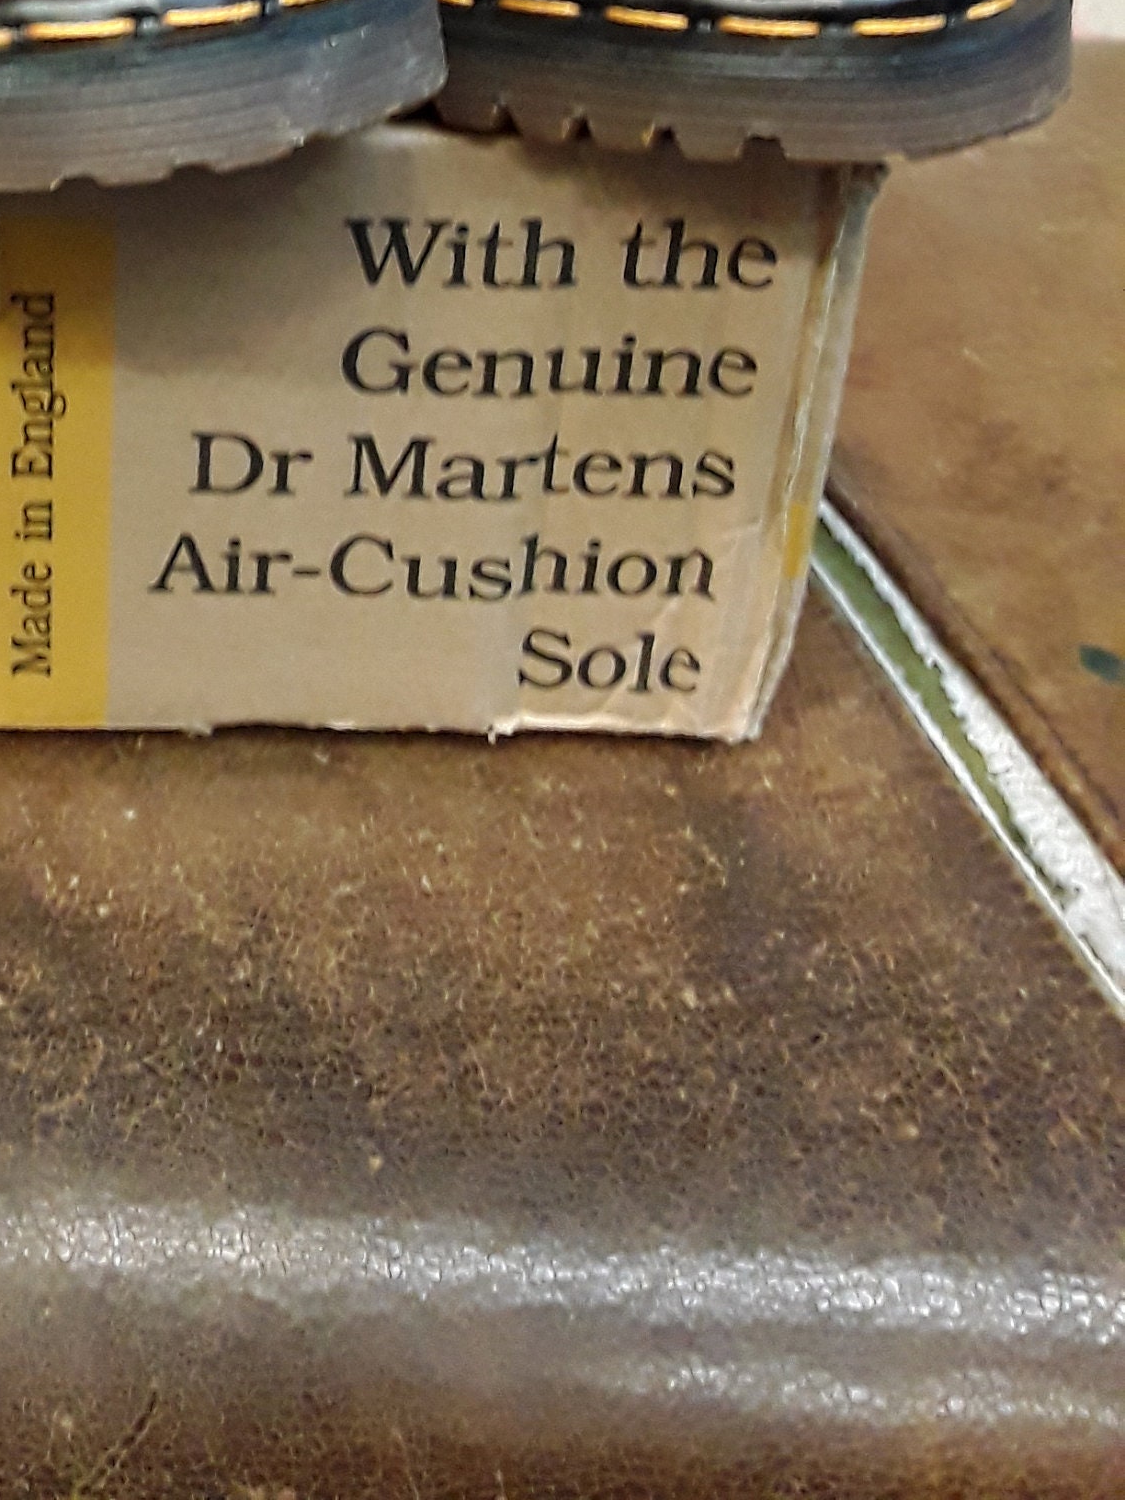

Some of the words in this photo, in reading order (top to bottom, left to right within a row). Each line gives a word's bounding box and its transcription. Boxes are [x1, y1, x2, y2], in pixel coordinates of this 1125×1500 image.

[344, 217, 577, 290] With
[619, 217, 778, 290] the
[10, 291, 67, 482] England
[342, 326, 758, 398] Genuine
[190, 430, 313, 497] Dr
[344, 430, 736, 501] Martens
[12, 502, 55, 544] in
[149, 531, 716, 601] Air-Cushion
[10, 559, 54, 680] Made
[517, 627, 703, 695] Sole
